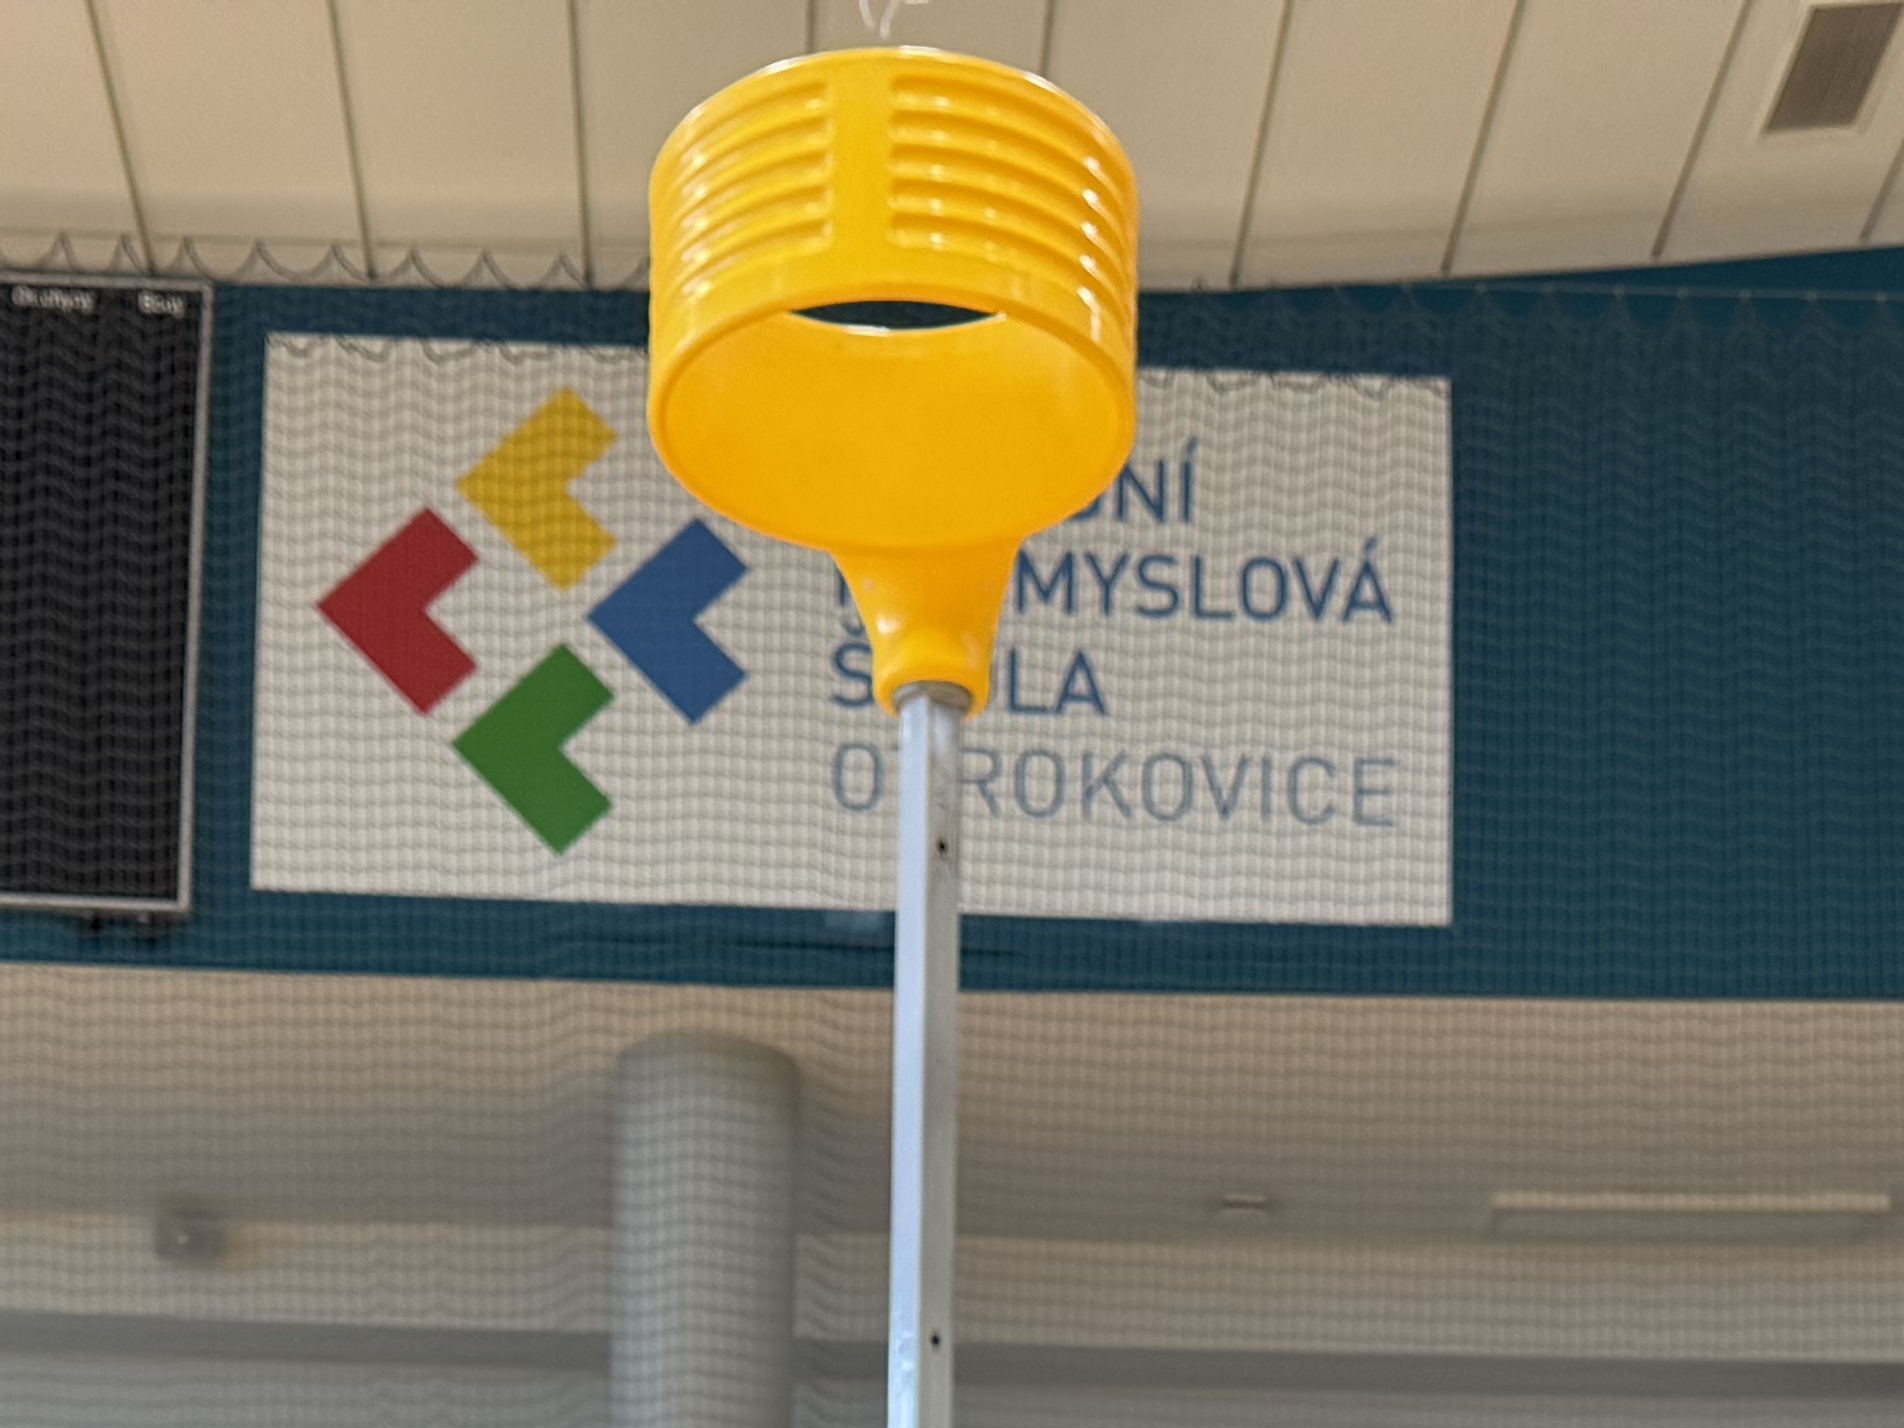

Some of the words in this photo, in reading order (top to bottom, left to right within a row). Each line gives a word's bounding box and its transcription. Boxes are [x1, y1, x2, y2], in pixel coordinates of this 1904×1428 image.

[835, 535, 1394, 625] MYSLOVÁ
[829, 618, 1110, 717] ŠLA
[830, 741, 1396, 829] OROKOVICE
